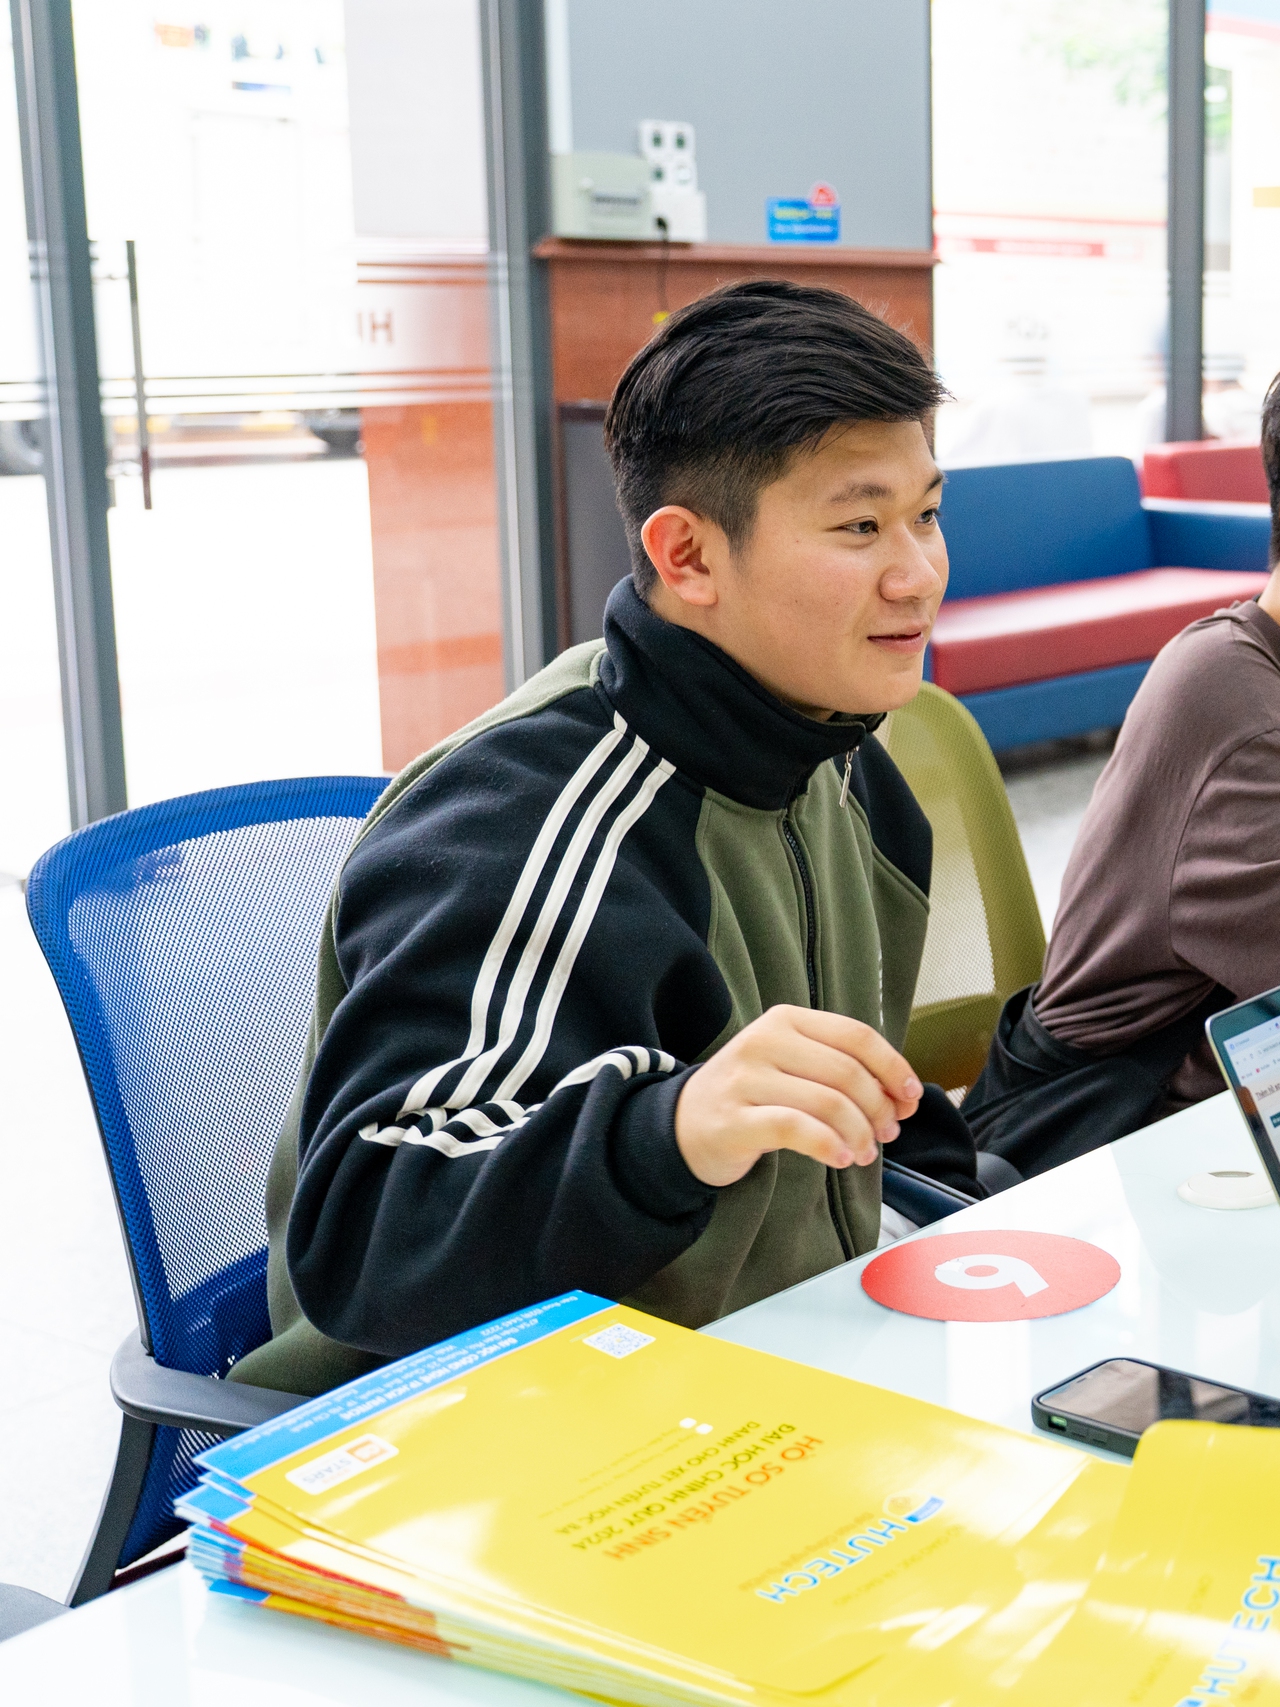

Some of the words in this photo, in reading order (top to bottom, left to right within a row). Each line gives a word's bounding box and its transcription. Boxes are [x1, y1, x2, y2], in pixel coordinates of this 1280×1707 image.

[622, 1502, 666, 1527] QUY
[571, 1525, 624, 1551] 2024
[603, 1526, 672, 1560] SINH
[756, 1518, 908, 1605] HUTECH
